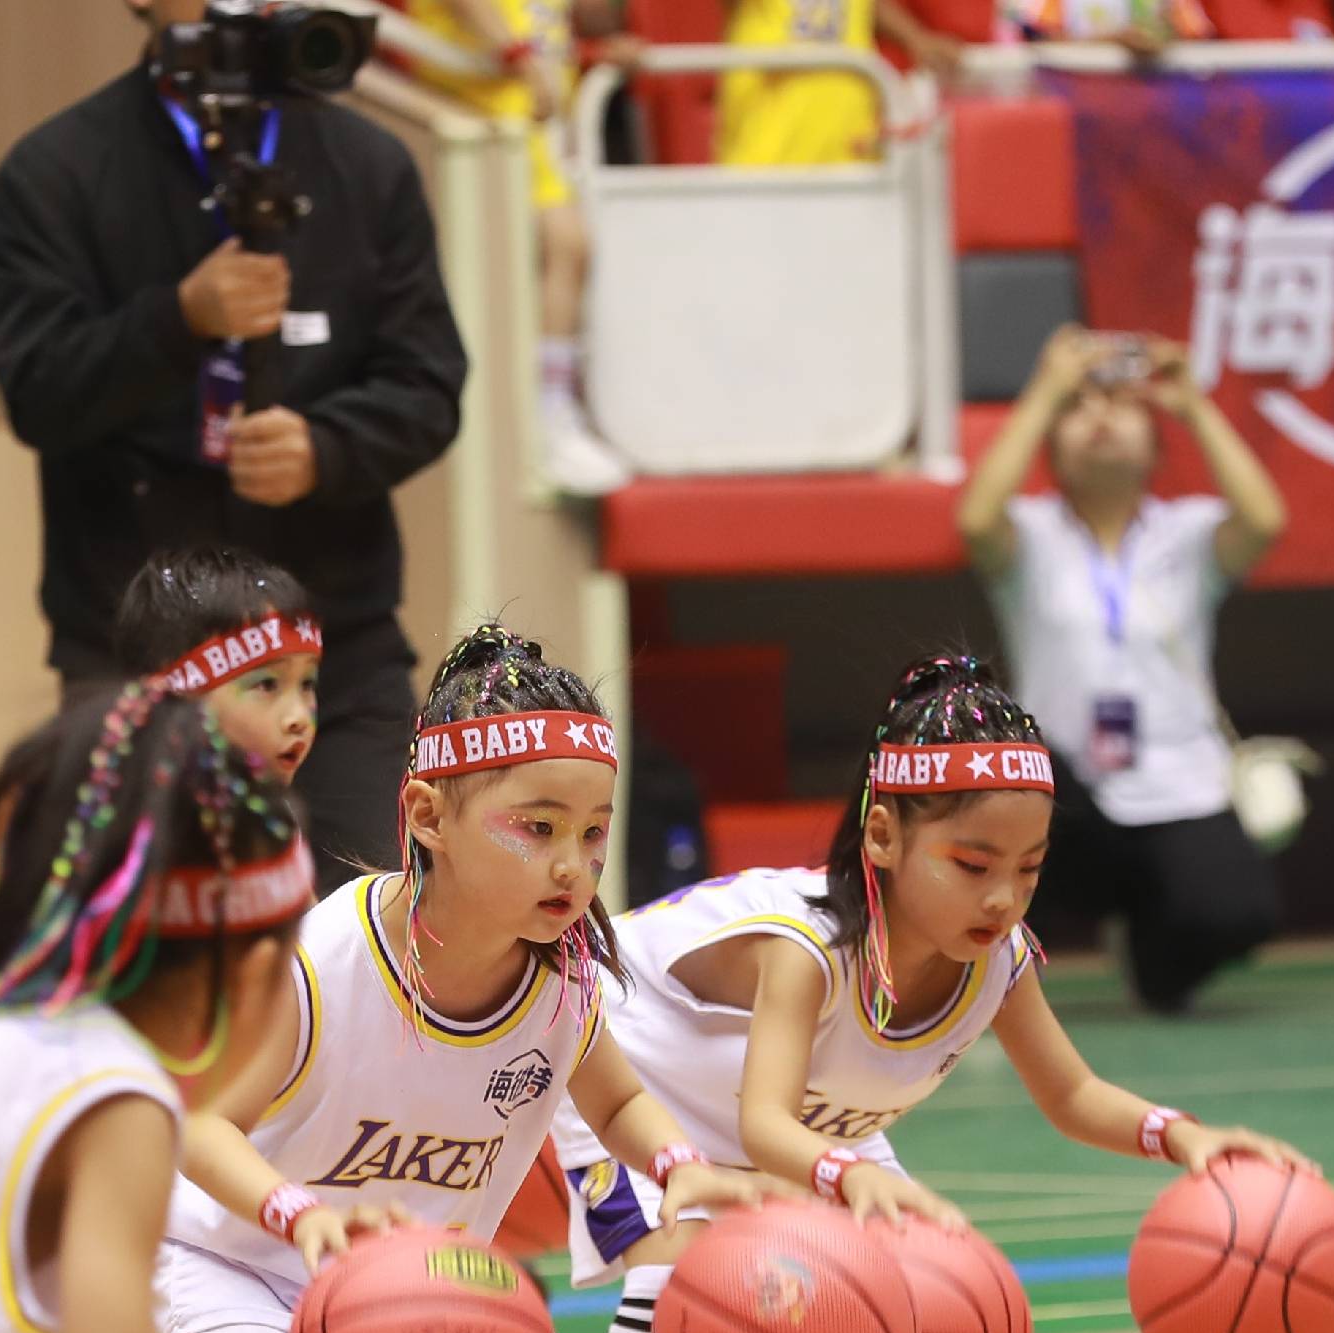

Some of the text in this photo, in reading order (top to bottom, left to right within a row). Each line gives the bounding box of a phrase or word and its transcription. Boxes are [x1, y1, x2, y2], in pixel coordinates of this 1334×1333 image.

[202, 617, 283, 678] BABY
[461, 718, 548, 763] BABY
[886, 752, 951, 785] BABY
